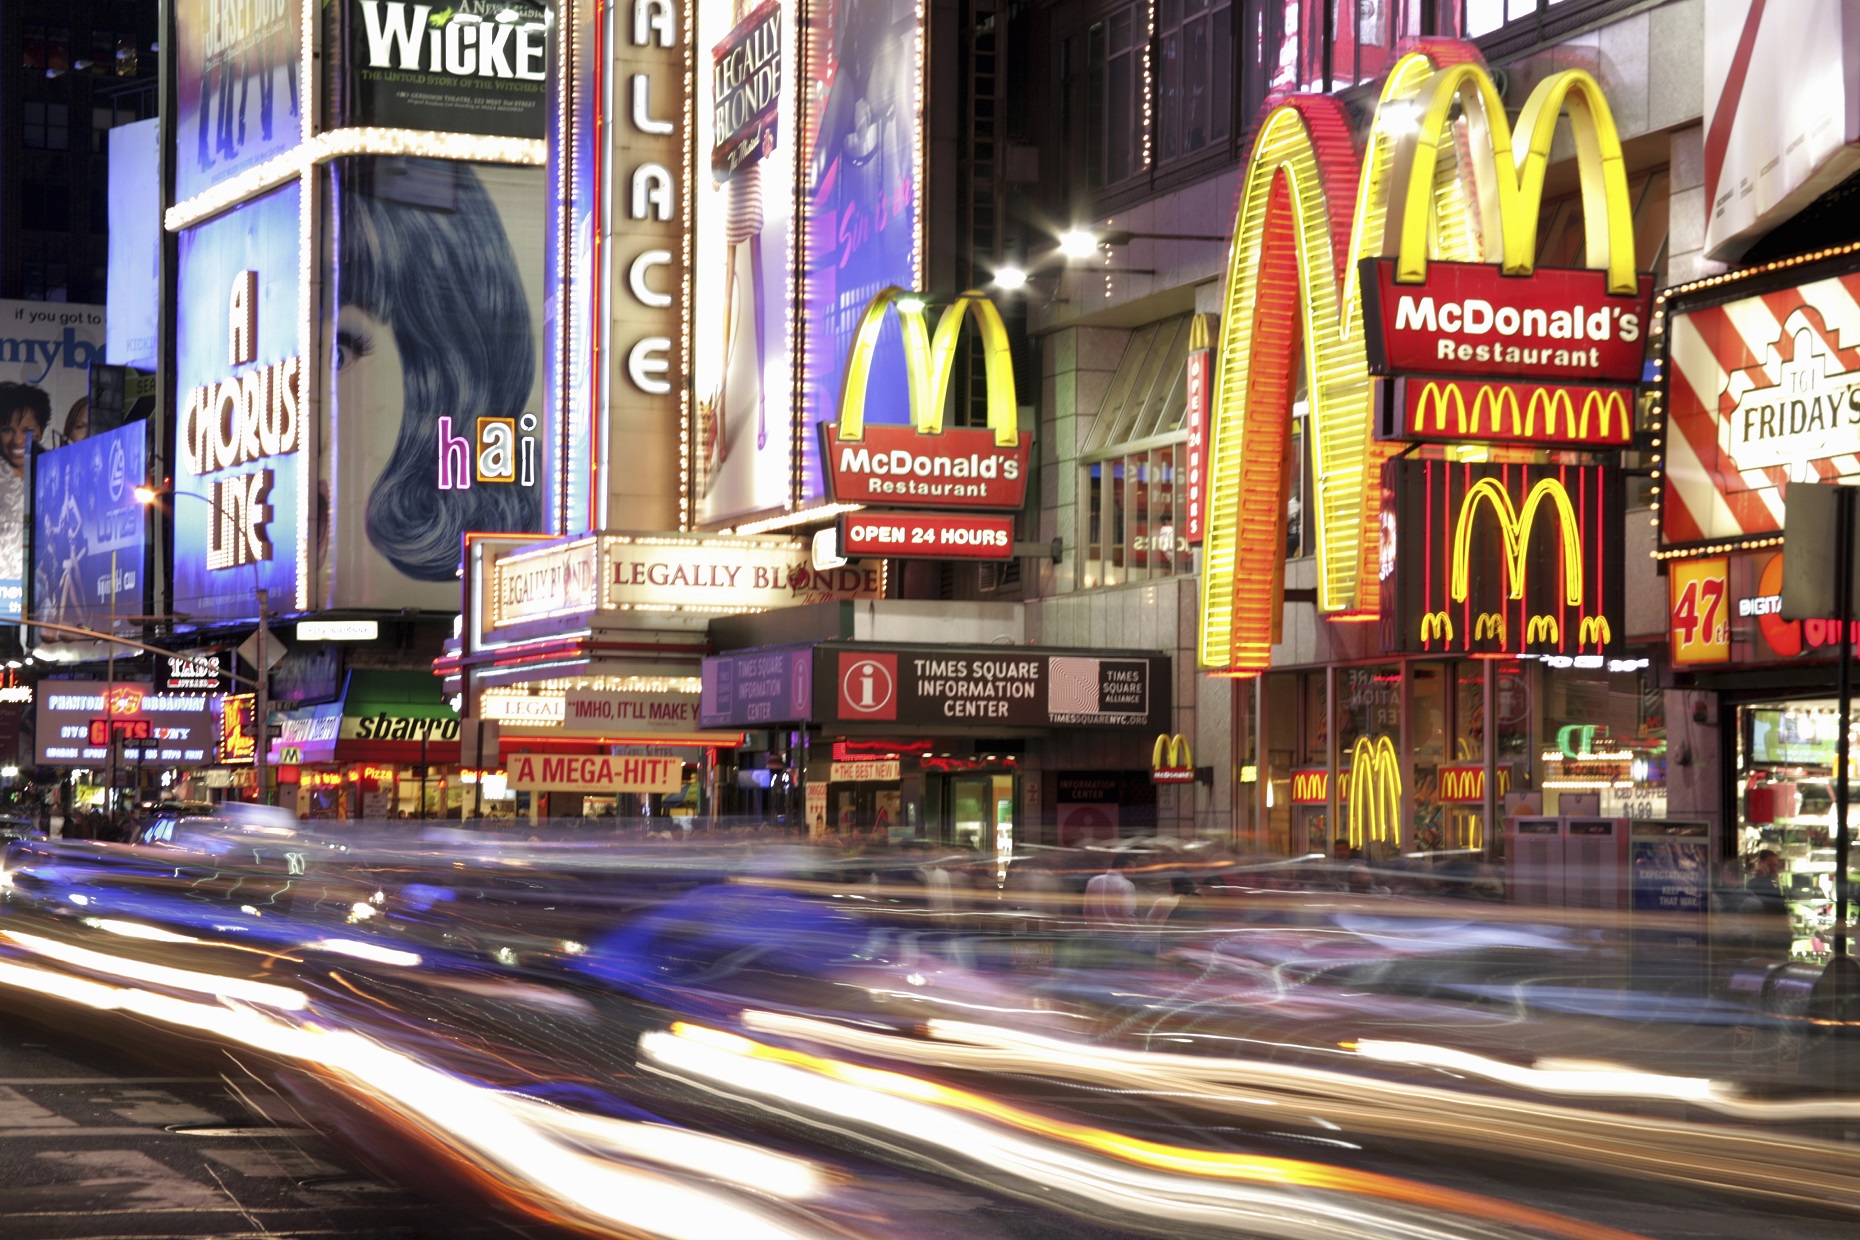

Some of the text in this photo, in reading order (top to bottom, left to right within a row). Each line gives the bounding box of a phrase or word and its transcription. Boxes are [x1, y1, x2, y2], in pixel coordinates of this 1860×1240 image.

[714, 10, 781, 105] LEGALLY
[362, 70, 382, 80] THE
[384, 72, 426, 83] UNTOLD
[427, 74, 458, 86] STORY
[475, 79, 493, 89] THE
[495, 80, 538, 92] WITCHES
[715, 54, 781, 148] BLONDE
[15, 308, 102, 326] if you got to
[228, 269, 259, 367] A
[1395, 296, 1640, 344] McDonald's
[1437, 339, 1600, 368] Restaurant
[1191, 361, 1200, 427] OPEN
[182, 354, 300, 476] CHORUS
[1742, 386, 1860, 444] FRIDAY'S
[1189, 435, 1201, 448] 24
[840, 447, 1019, 480] McDonald's
[868, 477, 988, 497] Restaurant
[1190, 452, 1199, 534] HOURS
[206, 468, 274, 571] LINE
[850, 525, 1008, 546] OPEN 24 HOURS
[613, 561, 879, 594] LEGALLY BLONDE
[738, 656, 783, 678] TIMES SQUARE
[914, 660, 1039, 681] TIMES SQUARE
[1107, 671, 1139, 682] TIMES
[739, 679, 780, 699] INFORMATION
[918, 680, 1035, 698] INFORMATION
[1103, 683, 1142, 694] SQUARE
[142, 696, 205, 711] BROADWAY
[944, 701, 1009, 717] CENTER
[1105, 694, 1140, 704] ALLIANCE
[617, 702, 646, 719] IT'LL
[650, 703, 688, 720] MAKE
[747, 702, 771, 720] CENTER
[1049, 714, 1148, 725] TIMESSQUARENYC.ORG
[356, 712, 460, 740] sbarro
[364, 767, 393, 780] Pizza
[855, 764, 874, 779] BEST
[875, 764, 892, 778] NEW
[1060, 780, 1116, 789] INFORMATION
[1072, 790, 1104, 799] CENTER
[1623, 801, 1652, 819] $1.99
[1660, 896, 1677, 906] THAT
